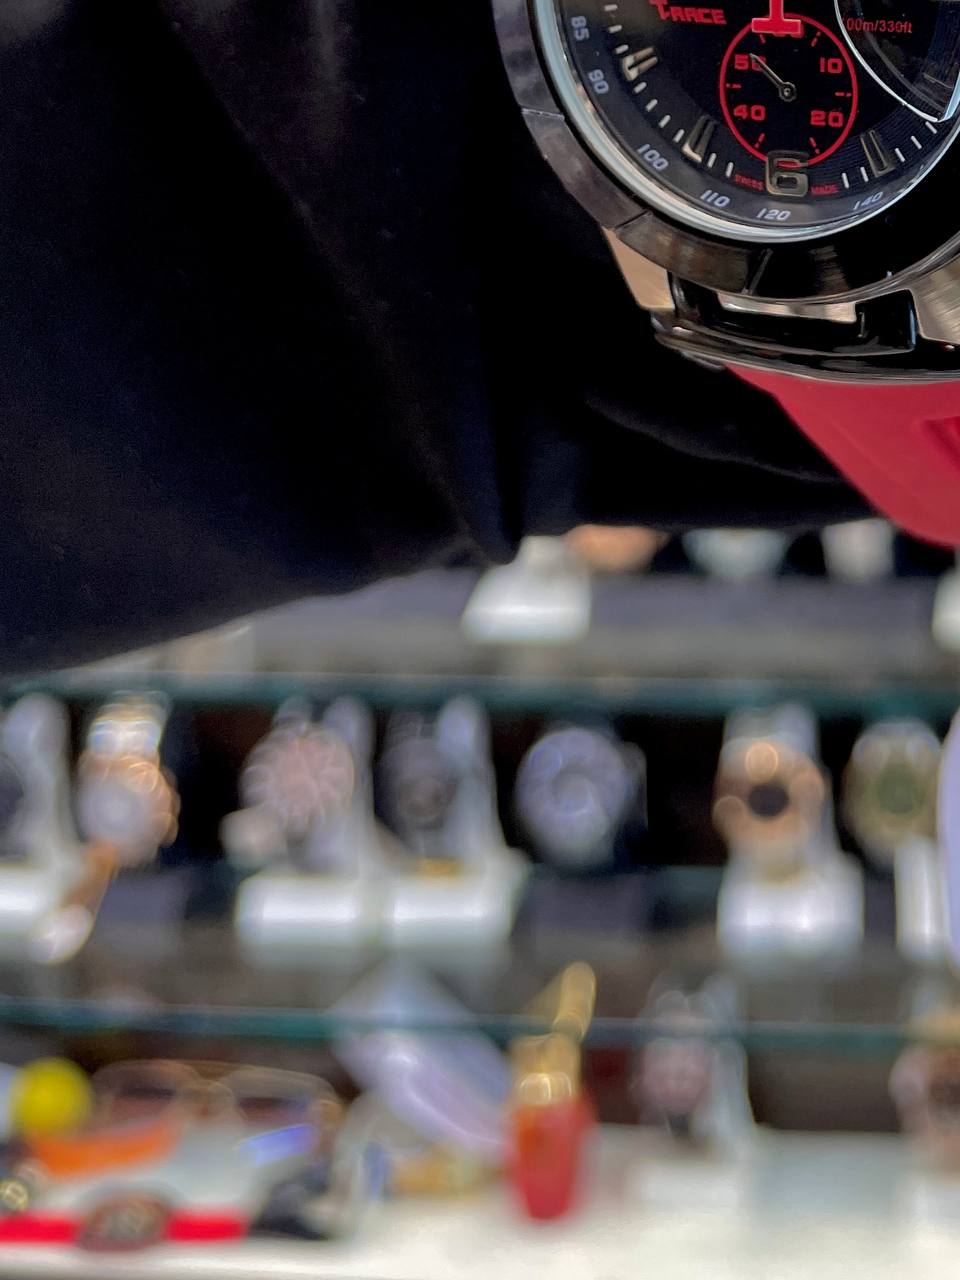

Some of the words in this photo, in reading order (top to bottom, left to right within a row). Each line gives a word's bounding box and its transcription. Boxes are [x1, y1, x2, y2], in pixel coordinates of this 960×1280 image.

[571, 15, 590, 41] 85
[841, 19, 912, 34] 00m/330ft
[820, 57, 843, 73] 10
[588, 69, 609, 94] 90
[733, 105, 766, 121] 40
[810, 109, 843, 127] 20
[637, 144, 669, 171] 100
[765, 150, 809, 197] 6
[700, 189, 730, 208] 110
[853, 191, 884, 210] 140
[756, 208, 791, 221] 120
